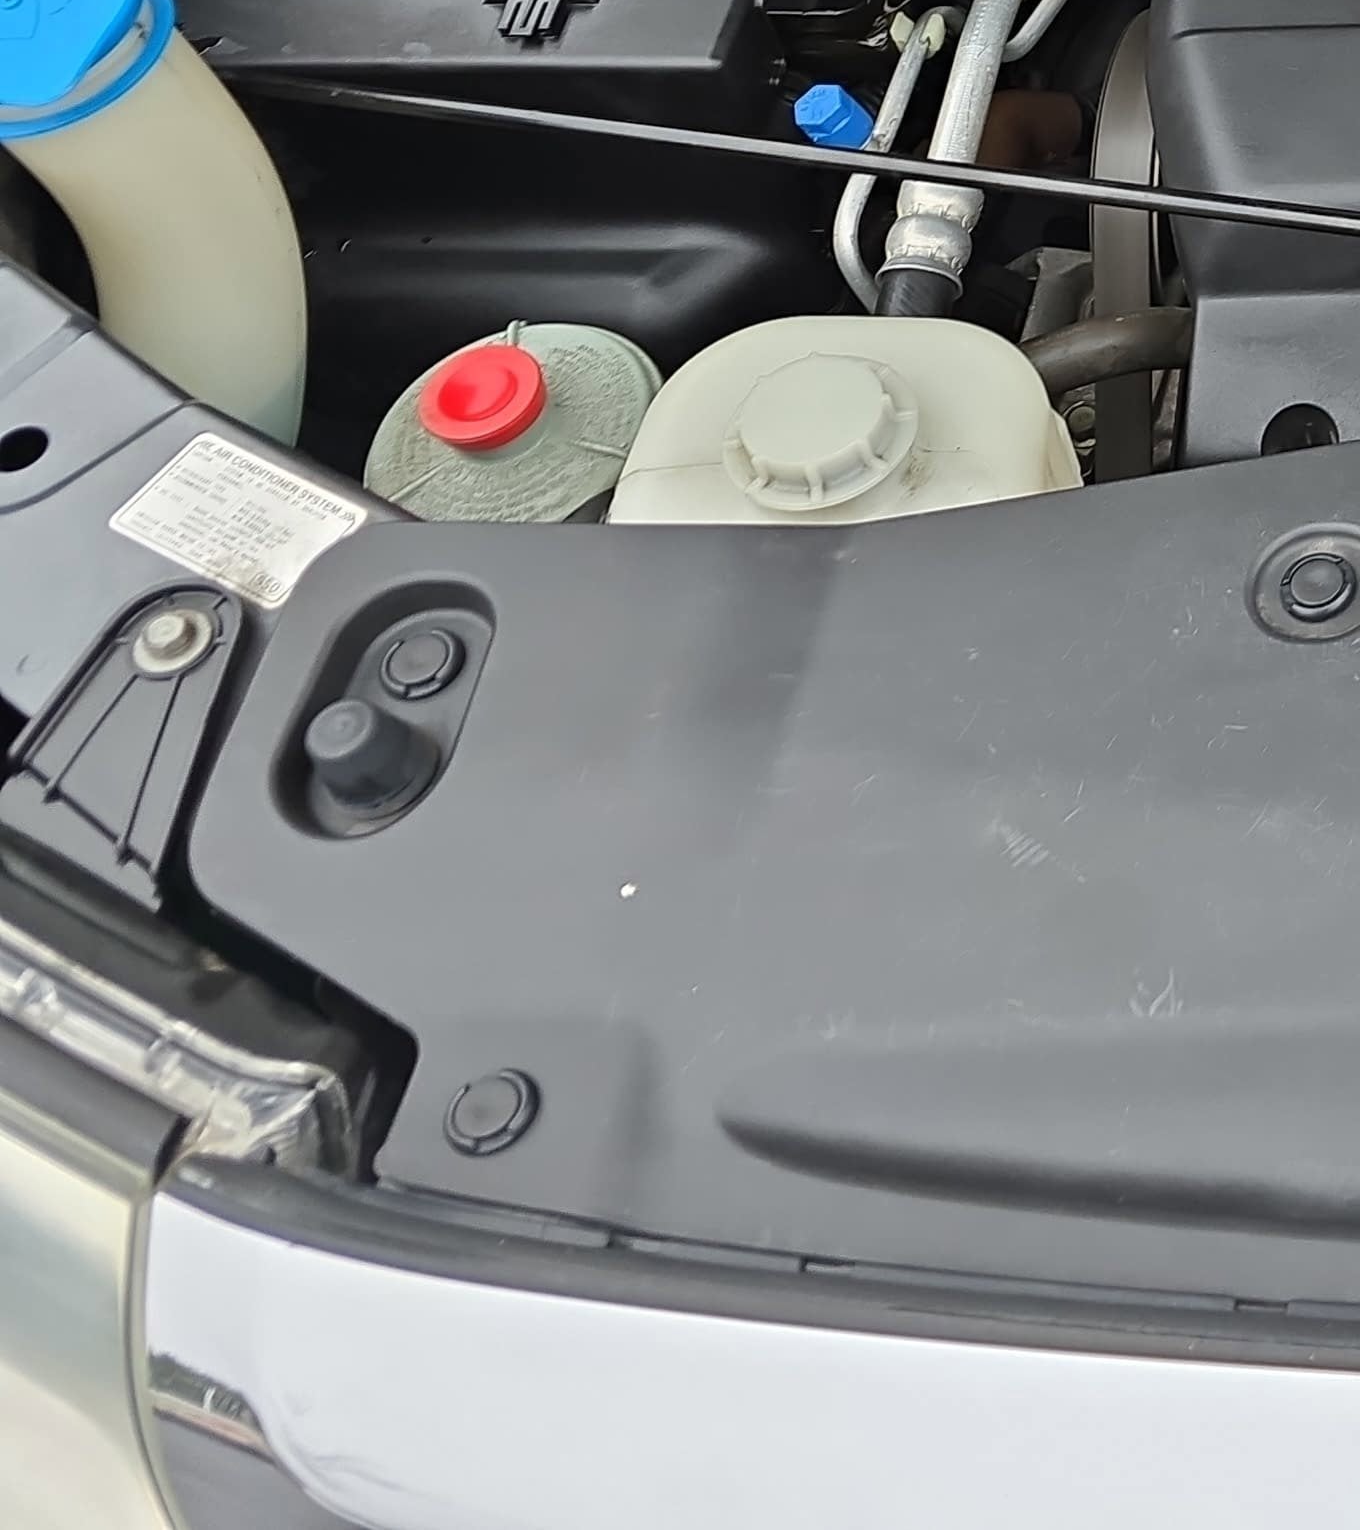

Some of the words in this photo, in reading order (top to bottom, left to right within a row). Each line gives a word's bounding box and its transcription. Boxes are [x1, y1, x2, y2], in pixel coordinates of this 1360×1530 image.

[213, 446, 232, 462] AIR
[231, 455, 300, 495] CONDITIONER
[298, 488, 343, 518] SYSTEM
